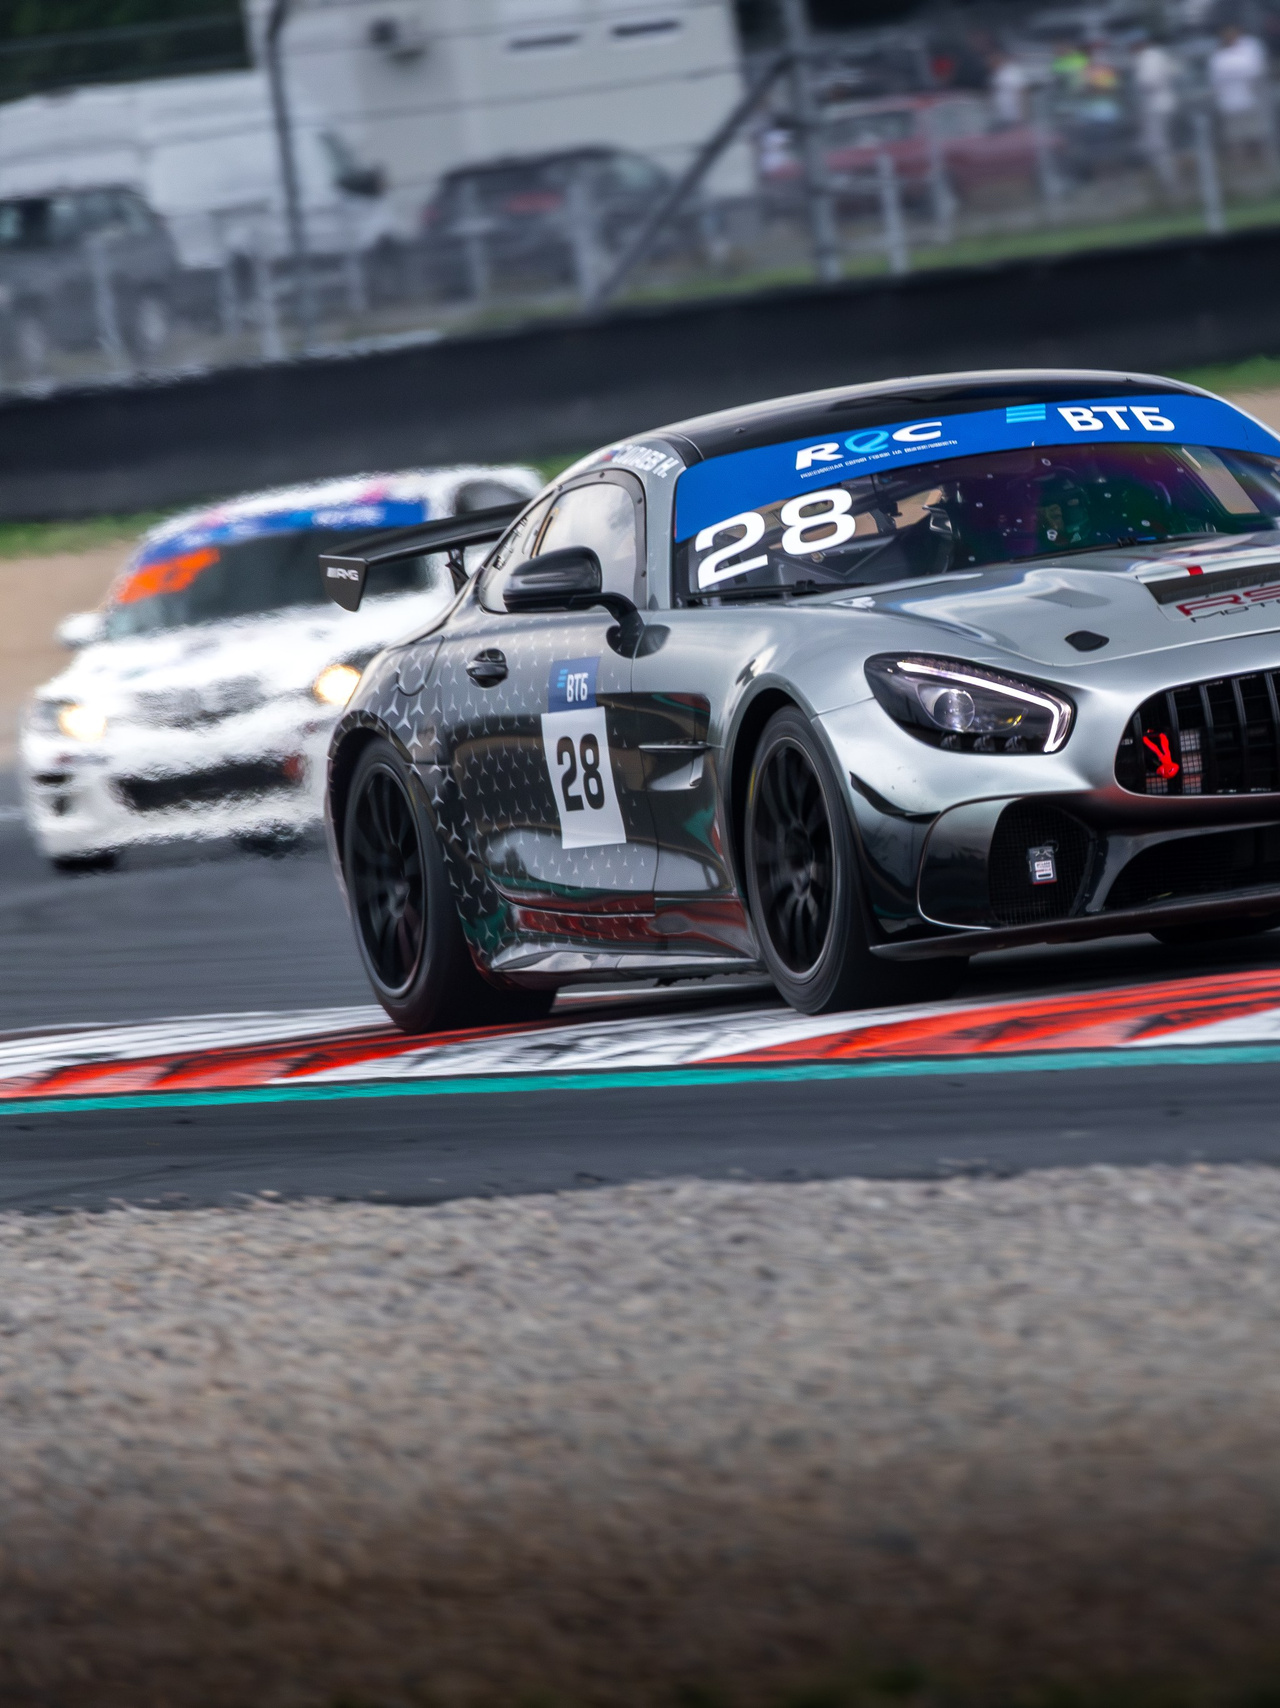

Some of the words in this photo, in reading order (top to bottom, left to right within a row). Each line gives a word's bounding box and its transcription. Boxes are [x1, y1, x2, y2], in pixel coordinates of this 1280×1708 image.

[1057, 405, 1175, 432] ВТБ
[695, 488, 856, 589] 28
[566, 673, 589, 702] ВТБ
[557, 733, 605, 812] 28
